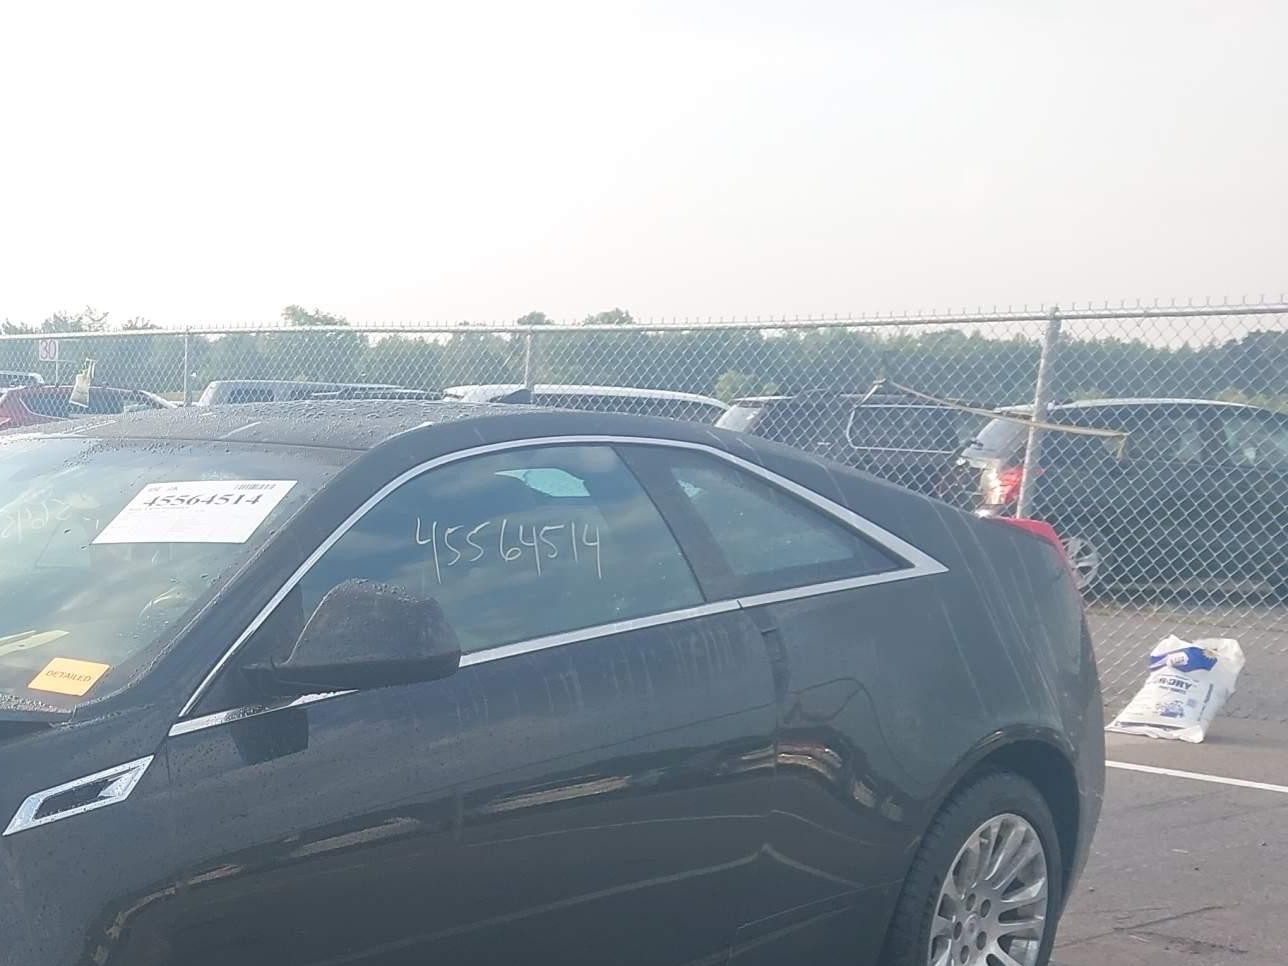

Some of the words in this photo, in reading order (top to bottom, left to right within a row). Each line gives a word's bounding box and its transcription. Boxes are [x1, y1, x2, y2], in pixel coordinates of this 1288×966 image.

[40, 340, 57, 360] 30
[143, 493, 264, 507] 45564514
[415, 517, 602, 584] 45564514
[45, 670, 93, 683] DETAILED
